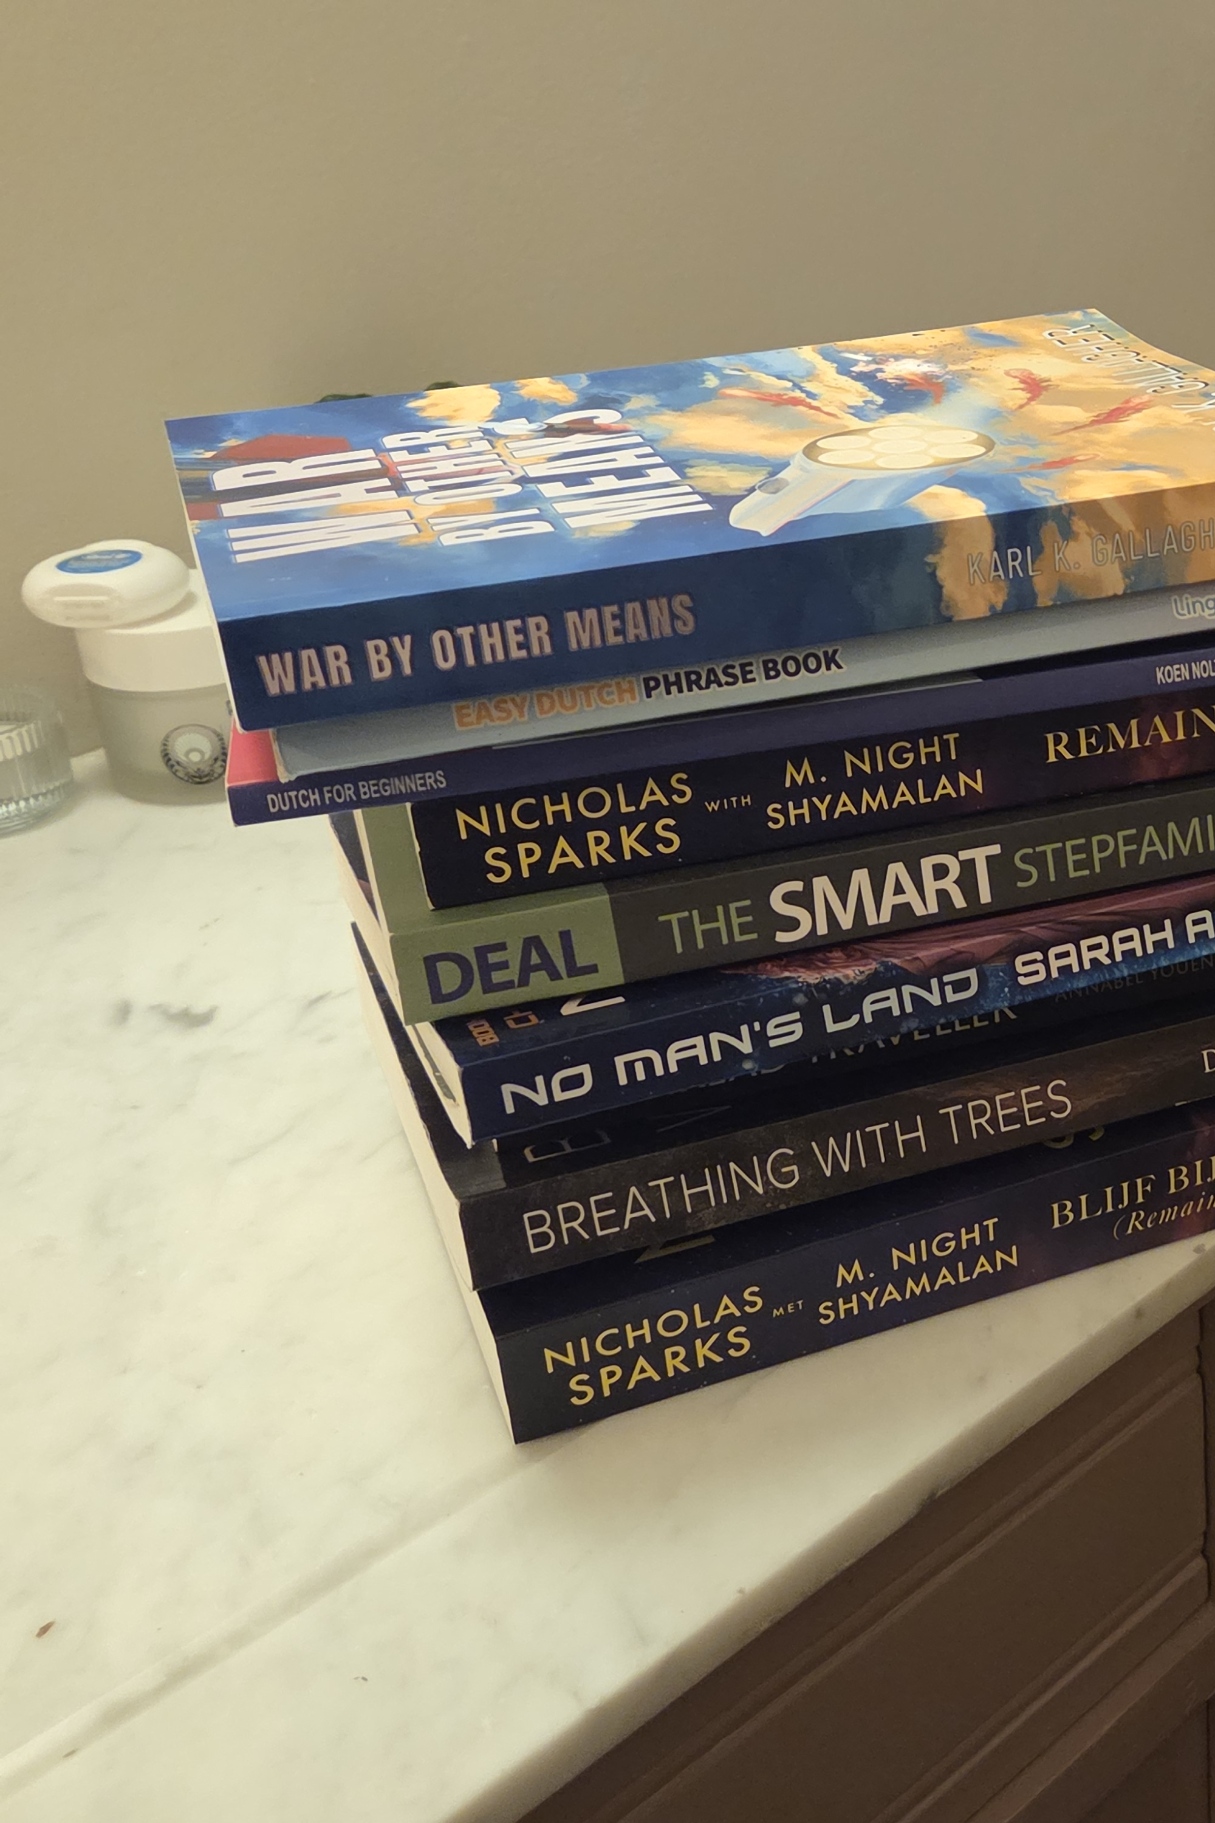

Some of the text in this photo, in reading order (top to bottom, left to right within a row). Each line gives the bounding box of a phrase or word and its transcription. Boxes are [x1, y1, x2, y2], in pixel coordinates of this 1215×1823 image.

[211, 448, 421, 563] WAR
[381, 426, 556, 547] BY OTHER
[494, 408, 714, 529] MEANS
[967, 546, 1042, 585] KARL
[1053, 541, 1080, 571] K.
[256, 594, 696, 697] WAR BY OTHER MEANS
[1155, 660, 1190, 685] KOEN
[454, 648, 843, 729] EASY DUTCH PHRASE BOOK
[267, 770, 447, 814] DUTCH FOR BEGINNERS
[785, 733, 960, 788] M. NIGHT
[455, 772, 693, 841] NICHOLAS
[704, 794, 752, 813] WITH
[766, 769, 984, 830] SHYAMALAN
[484, 817, 681, 884] SPARKS
[658, 899, 758, 954] THE
[769, 844, 1001, 943] SMART
[422, 929, 599, 1005] DEAL
[1014, 918, 1175, 986] SARAH
[500, 1063, 594, 1114] NO
[614, 1011, 804, 1086] MAN'S
[821, 967, 980, 1033] LAND
[523, 1079, 1072, 1254] BREATHING WITH TREES
[1050, 1174, 1156, 1230] BLIJF
[818, 1245, 1018, 1325] SHYAMALAN
[836, 1217, 999, 1289] M. NIGHT
[543, 1285, 764, 1374] NICHOLAS
[772, 1300, 805, 1318] MET
[568, 1325, 752, 1407] SPARKS
